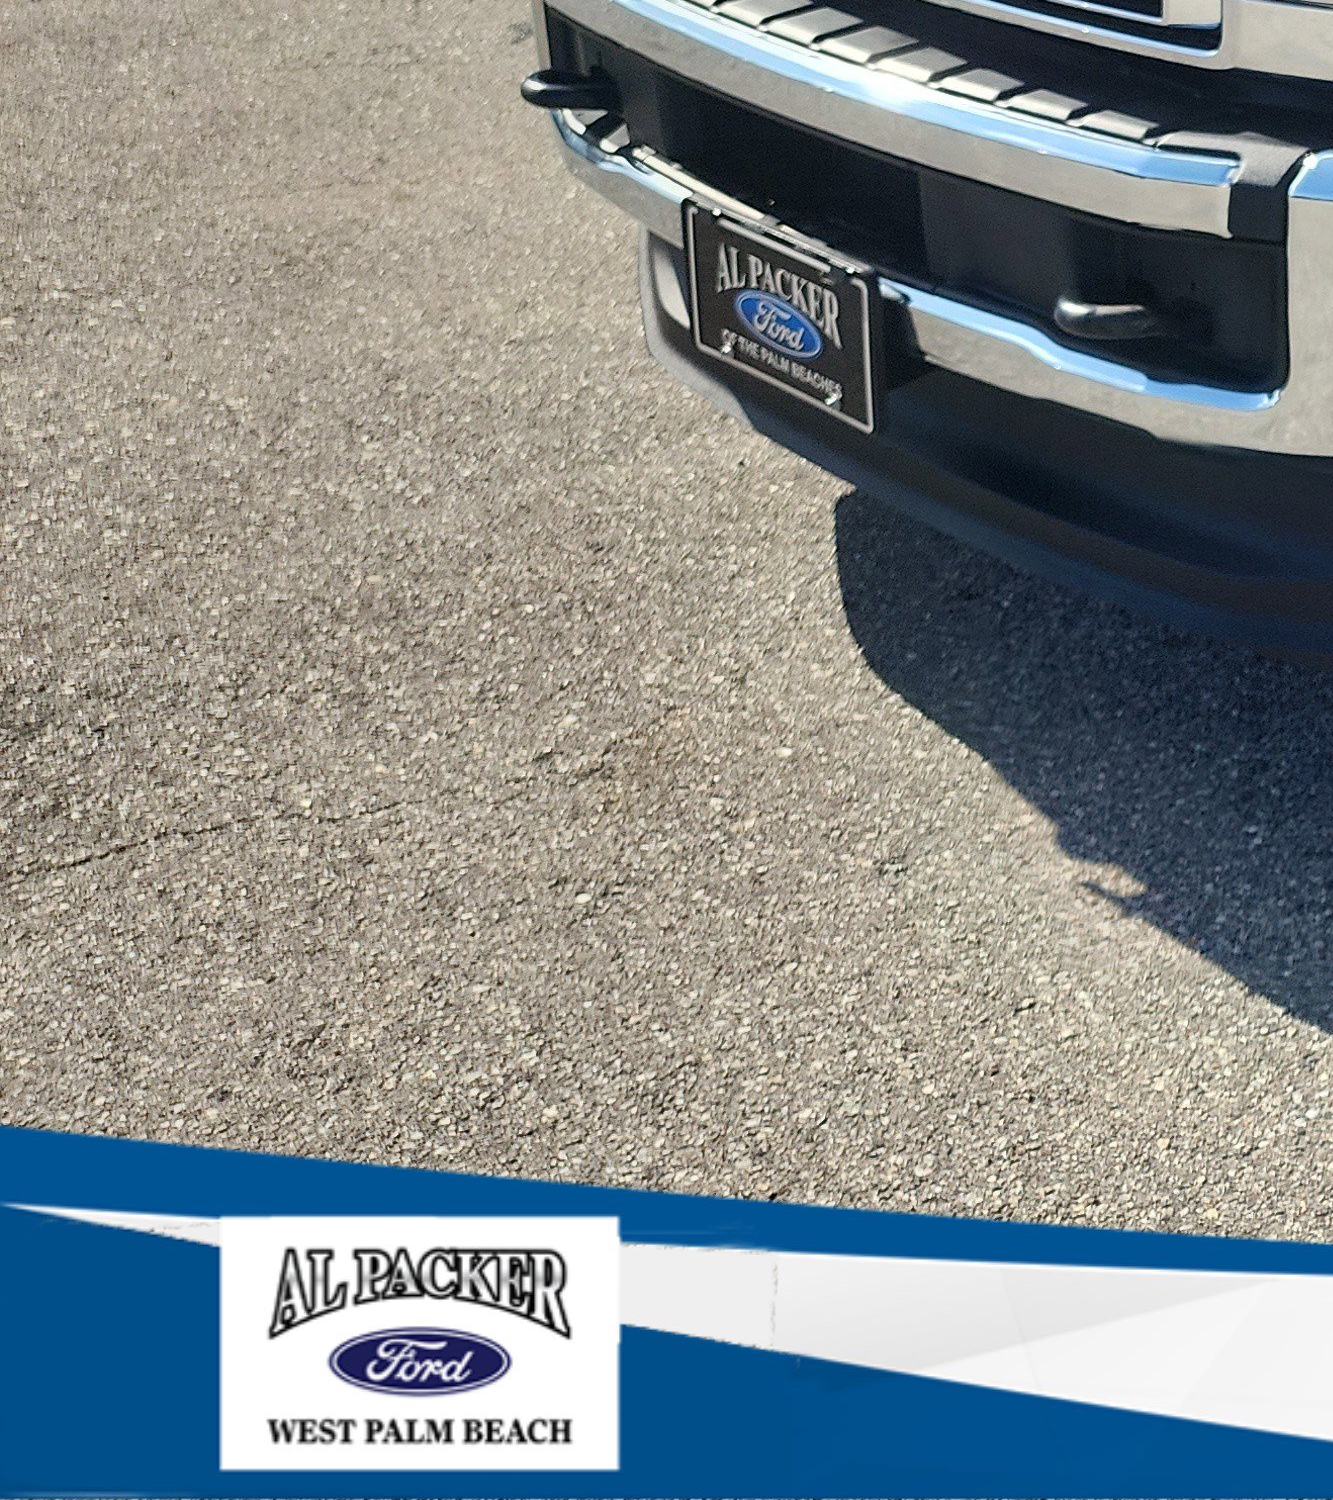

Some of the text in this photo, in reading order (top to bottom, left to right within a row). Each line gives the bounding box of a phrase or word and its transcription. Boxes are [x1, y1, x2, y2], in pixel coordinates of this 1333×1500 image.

[716, 243, 843, 350] AL PACKER
[752, 300, 805, 350] Ford
[760, 347, 791, 374] PALM
